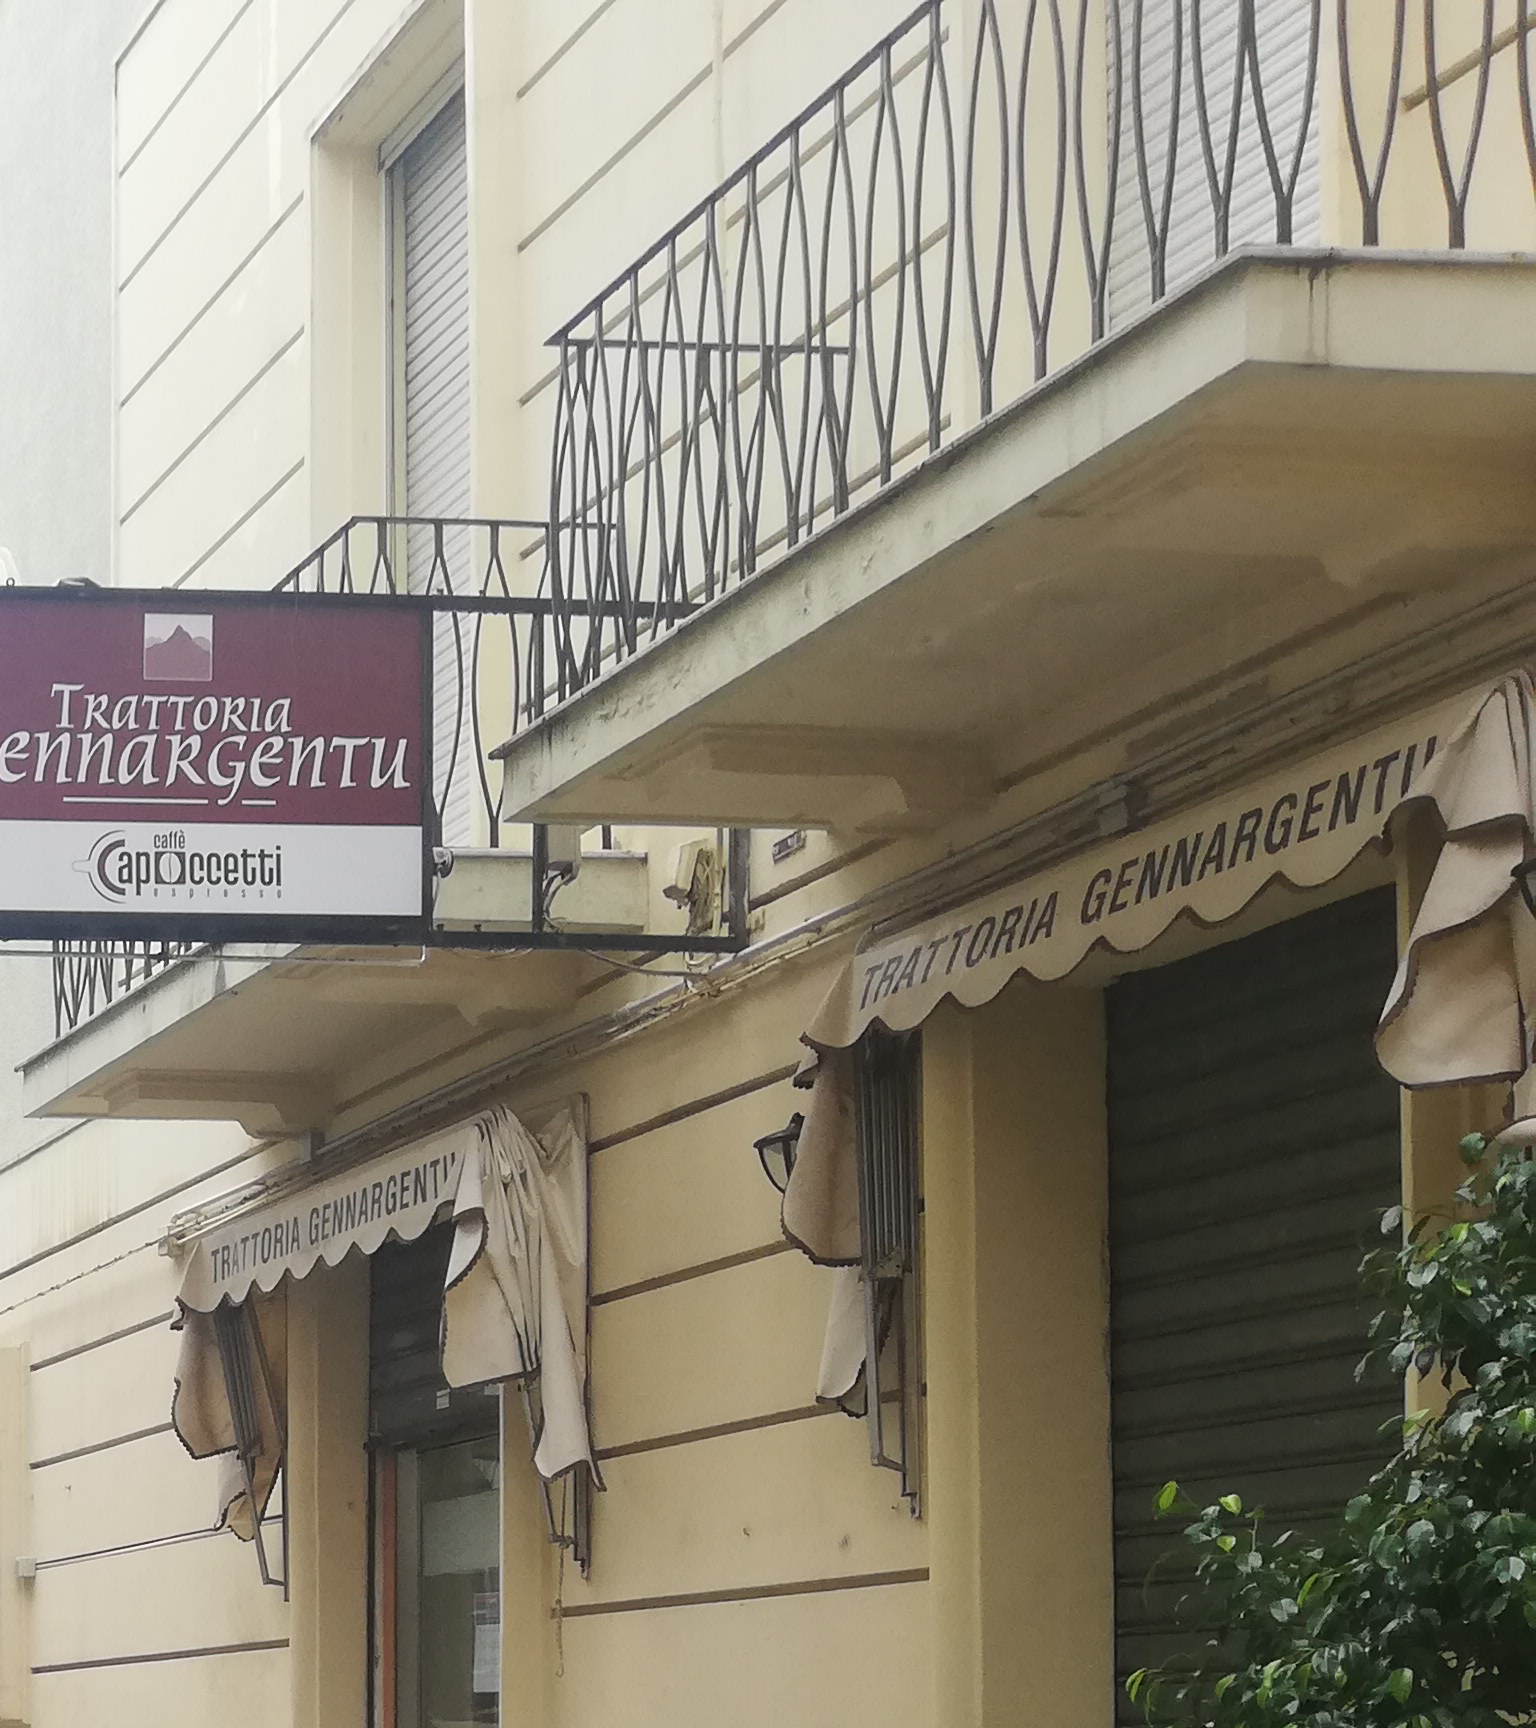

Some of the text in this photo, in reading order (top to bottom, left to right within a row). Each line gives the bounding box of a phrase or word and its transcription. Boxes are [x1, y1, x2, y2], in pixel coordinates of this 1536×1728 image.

[153, 829, 186, 849] caffè
[153, 887, 282, 899] espresso
[859, 890, 1060, 1010] TRATTORIA
[210, 1218, 301, 1284] TRATTORIA
